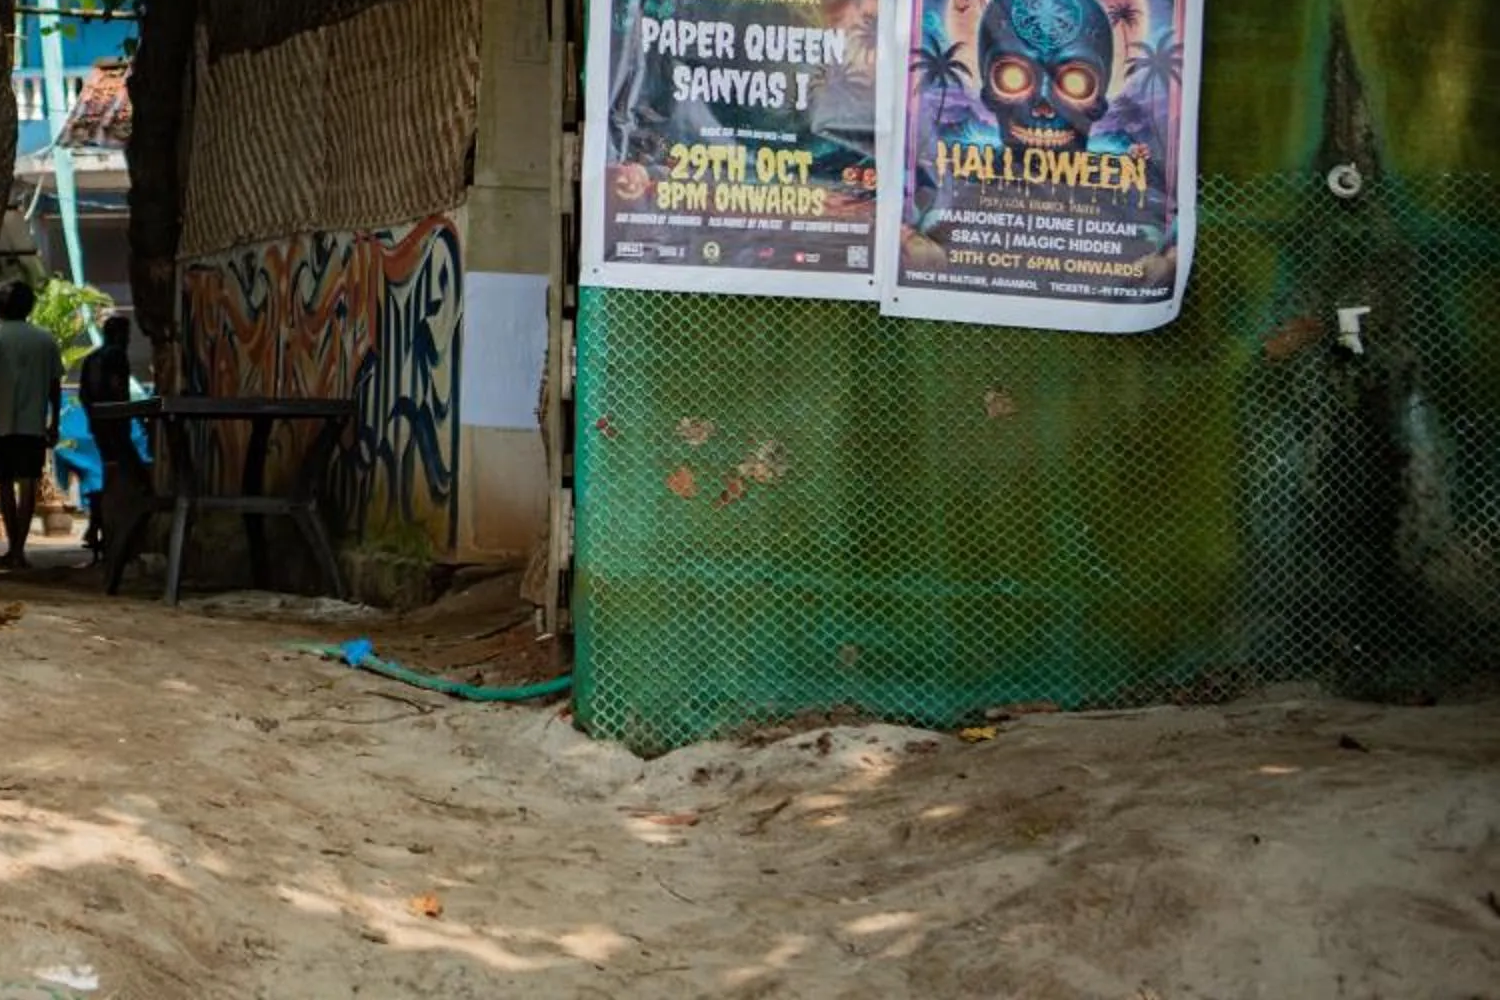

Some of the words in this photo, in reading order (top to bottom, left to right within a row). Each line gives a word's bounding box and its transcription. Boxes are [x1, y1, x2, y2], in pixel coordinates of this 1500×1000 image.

[641, 17, 736, 60] PAPER
[744, 23, 847, 65] QUEEN
[672, 65, 787, 109] SANYAS
[795, 72, 810, 110] I
[669, 144, 747, 183] 29TH
[756, 147, 813, 186] OCT
[935, 140, 1148, 194] HALLOWEEN
[656, 181, 708, 212] 8PM
[715, 182, 826, 216] ONWARDS
[939, 208, 1025, 227] MARIONETA
[1035, 216, 1074, 232] DUNE
[1086, 219, 1137, 237] DUXAN
[951, 229, 1001, 245] SRAYA
[1012, 234, 1066, 251] MAGIC
[1069, 238, 1122, 255] HIDDEN
[949, 249, 984, 266] 31TH
[987, 253, 1021, 269] OCT
[1027, 254, 1061, 271] 6PM
[1064, 258, 1144, 278] ONWARDS
[991, 276, 1039, 290] ARAMBOL
